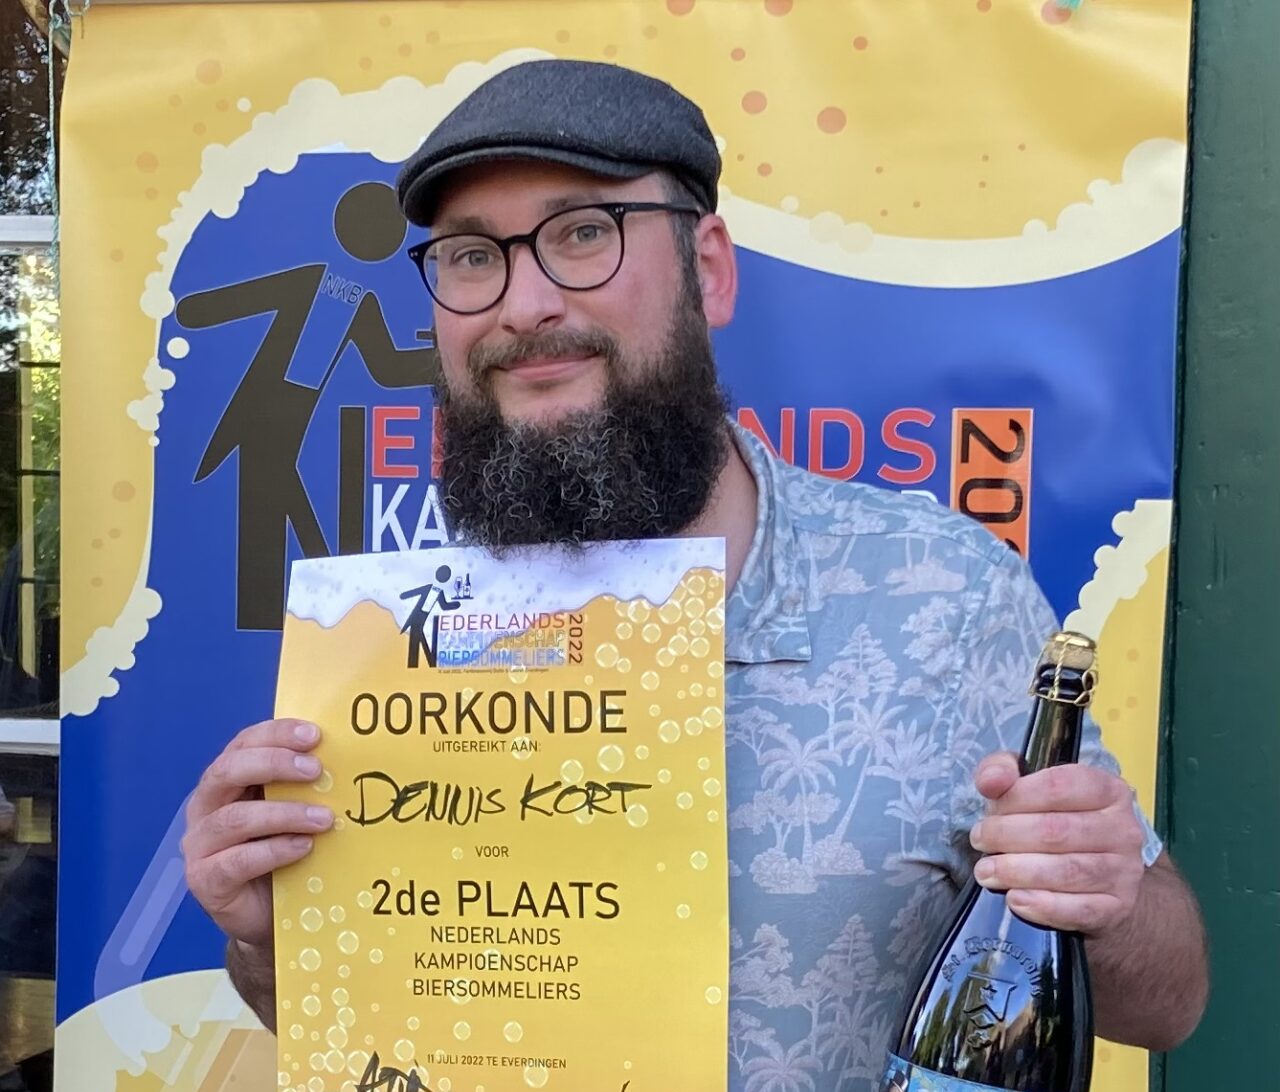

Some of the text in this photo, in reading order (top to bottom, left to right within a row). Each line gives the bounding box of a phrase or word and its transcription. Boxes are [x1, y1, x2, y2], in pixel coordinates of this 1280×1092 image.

[321, 273, 363, 305] NKB
[960, 418, 1026, 552] 20
[569, 614, 583, 664] 2022
[351, 690, 627, 735] OORKONDE
[433, 740, 541, 753] UITGEREIKT AAN:
[520, 773, 652, 821] KORT
[475, 846, 509, 857] VOOR
[371, 879, 620, 919] 2de PLAATS
[431, 926, 561, 945] NEDERLANDS
[414, 952, 578, 972] KAMPIOENSCHAP
[413, 979, 581, 1000] BIERSOMMELIERS
[427, 1054, 566, 1069] 11 JULI 2022 TE EVERDINGEN
